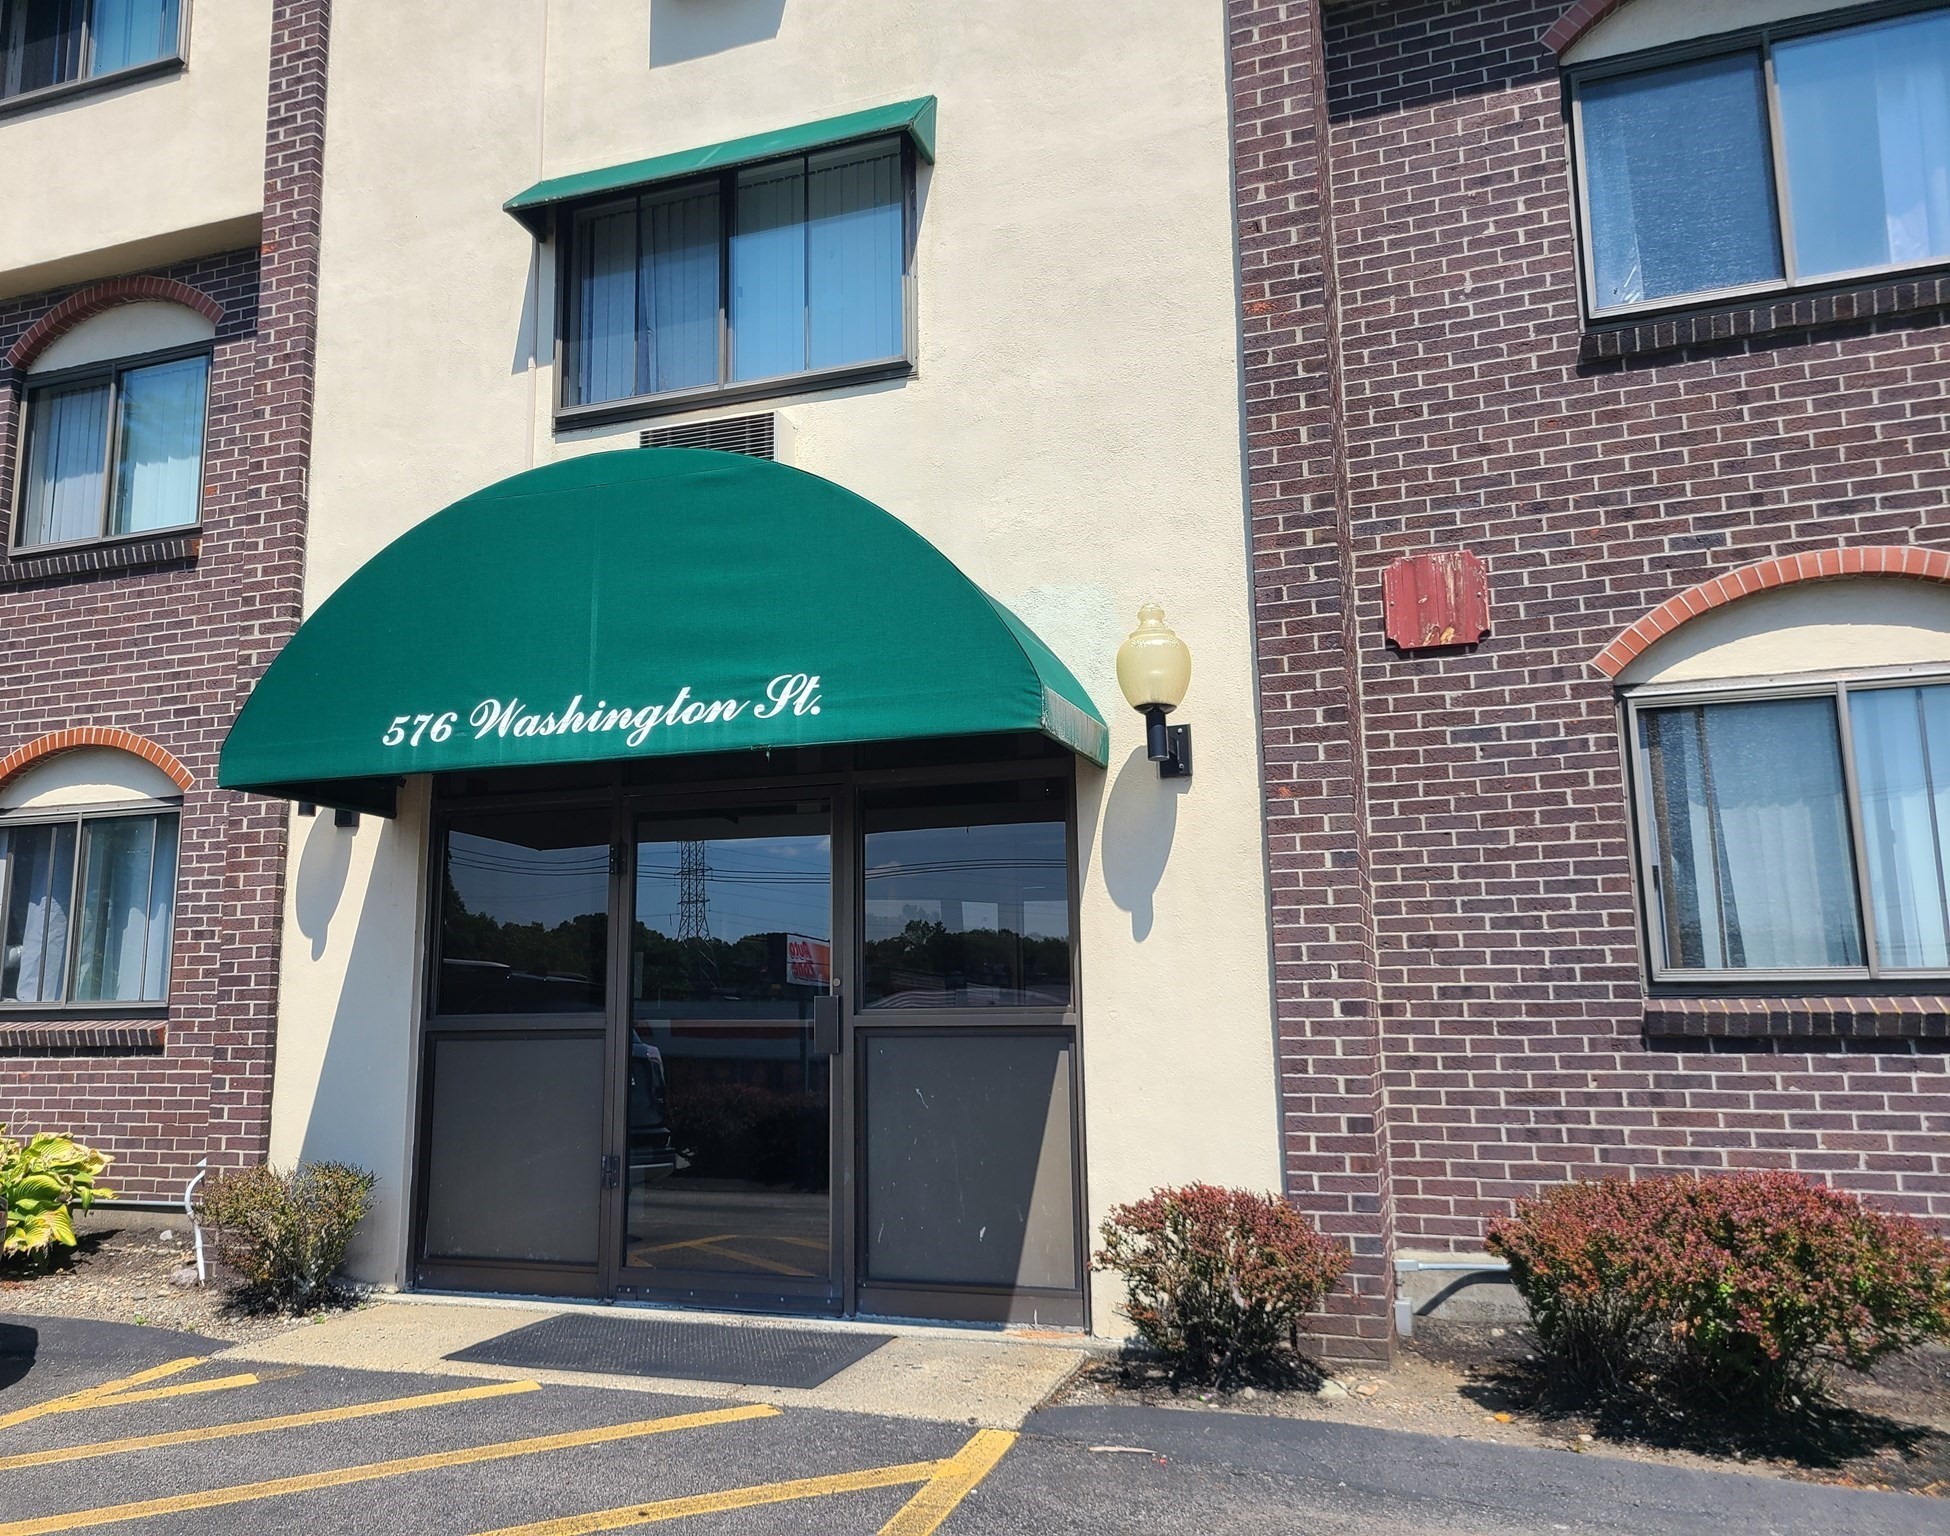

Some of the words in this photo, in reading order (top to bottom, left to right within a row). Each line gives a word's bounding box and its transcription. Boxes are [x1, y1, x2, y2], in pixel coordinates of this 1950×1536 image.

[382, 711, 458, 747] 576
[469, 686, 751, 747] Washington
[753, 672, 822, 719] St.
